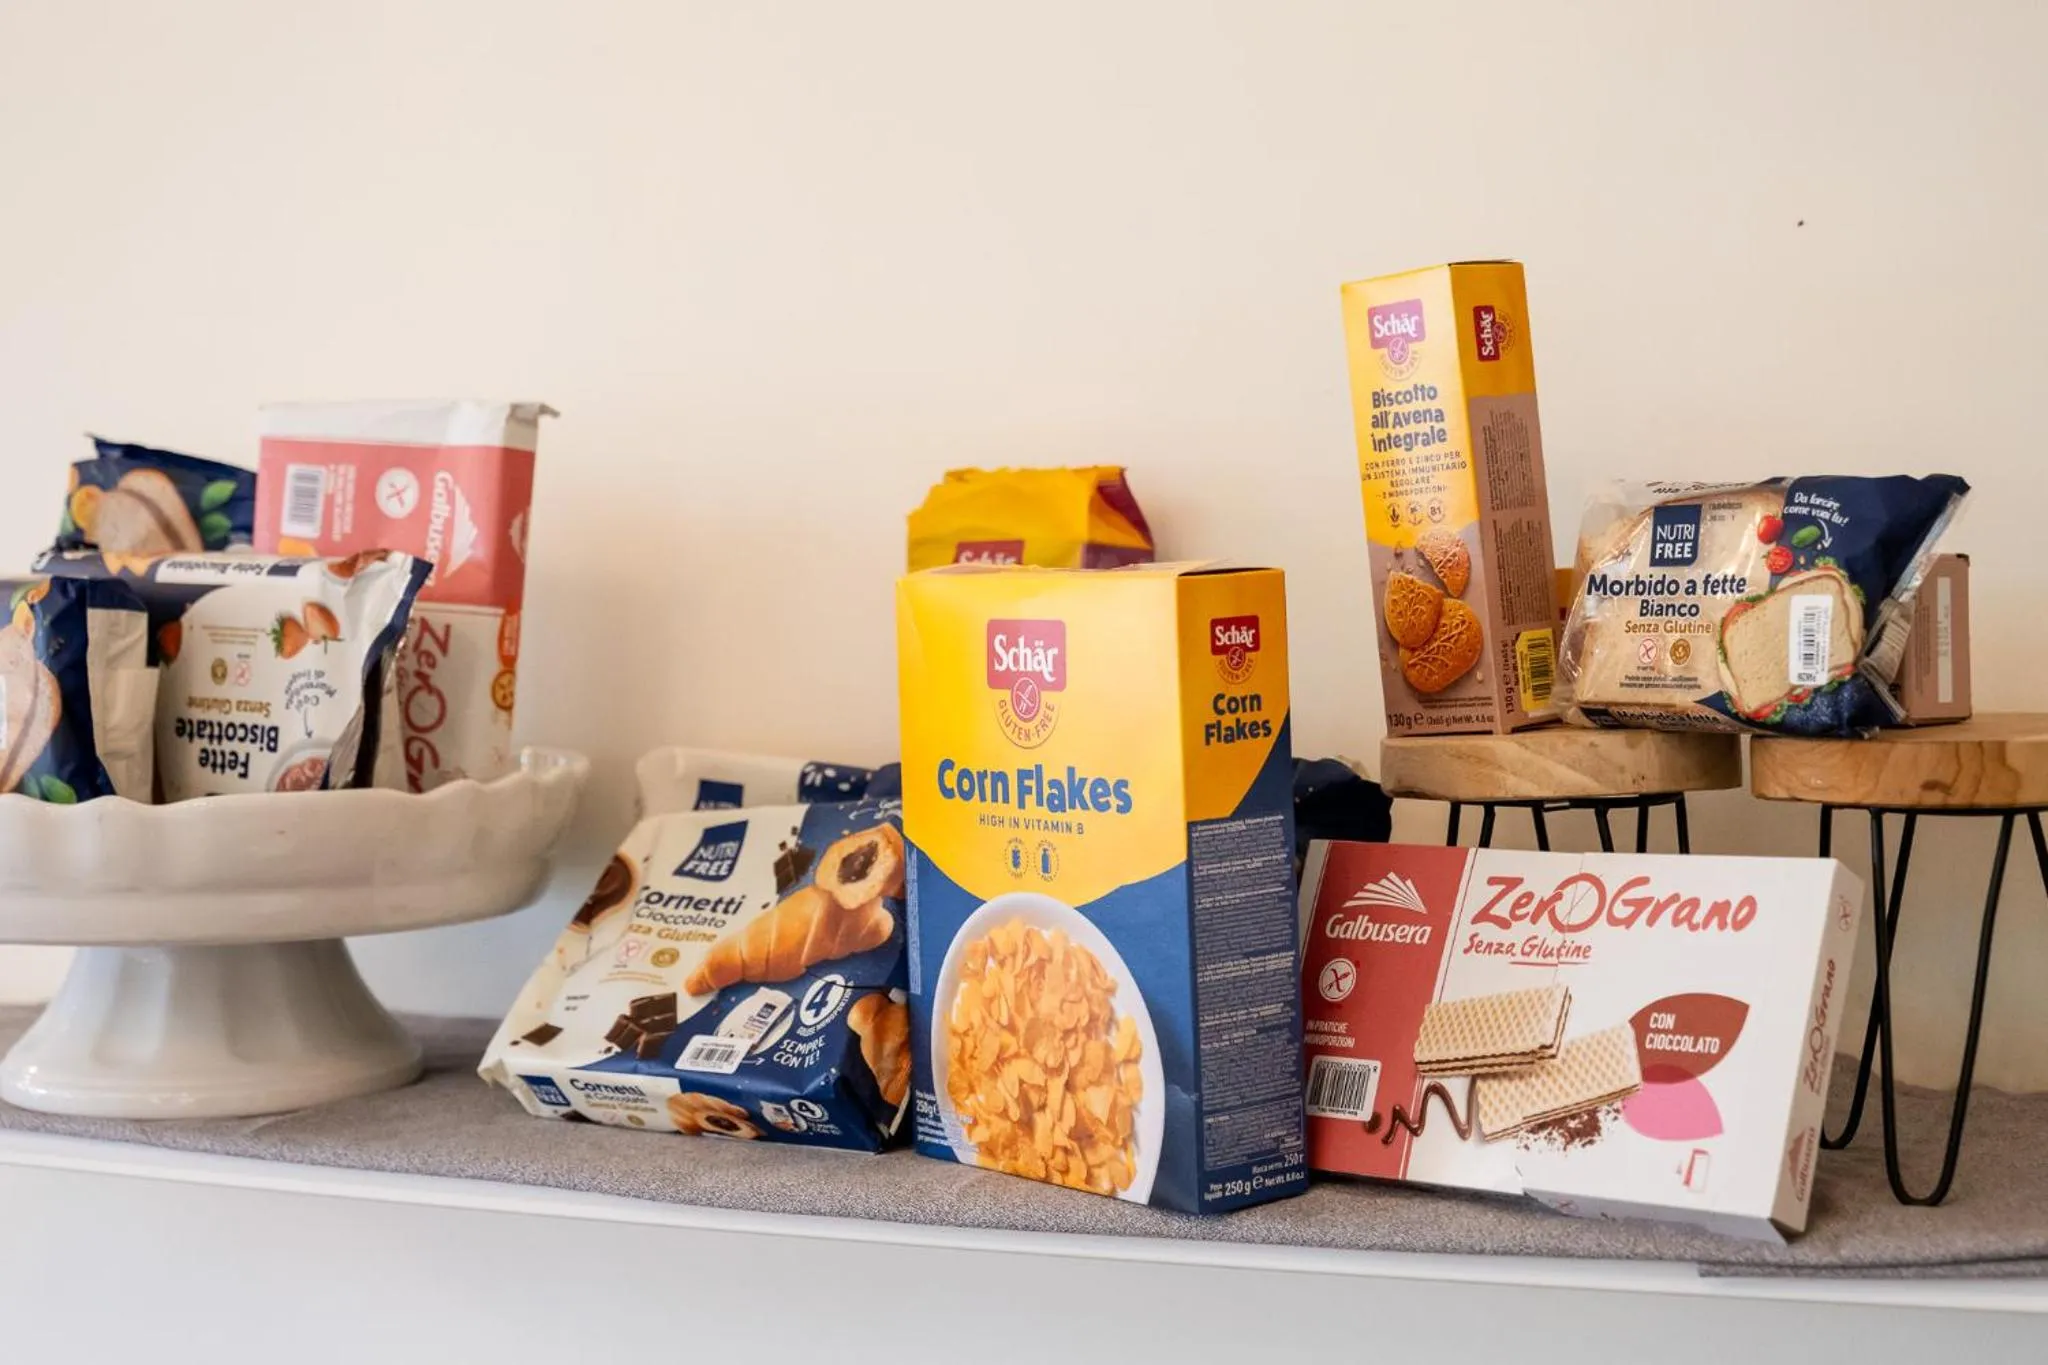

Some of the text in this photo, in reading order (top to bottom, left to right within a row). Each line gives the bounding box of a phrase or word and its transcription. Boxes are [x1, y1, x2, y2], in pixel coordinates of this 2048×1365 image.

[1372, 311, 1420, 339] Schär
[1480, 310, 1494, 356] Schär
[1371, 384, 1438, 409] Biscotto
[1371, 408, 1445, 430] all'Avena
[1371, 425, 1448, 452] integrale
[424, 468, 454, 588] Galbuse
[1655, 523, 1696, 541] NUTRI
[1655, 542, 1693, 559] FREE
[1586, 573, 1748, 597] Morbido a fette
[1639, 599, 1701, 618] Bianco
[1214, 624, 1256, 648] Schär
[1624, 620, 1713, 635] Senza Glutine
[993, 633, 1059, 682] Schär
[404, 617, 451, 794] ZerOGr
[1212, 692, 1262, 716] Corn
[998, 699, 1056, 742] GLUTEN-FREE
[1204, 717, 1272, 747] Flakes
[175, 717, 280, 753] Biscottate
[198, 747, 250, 778] Fette
[937, 758, 1133, 815] Corn Flakes
[979, 813, 1085, 835] HIGH IN VITAMIN B
[695, 841, 740, 860] NUTRI
[683, 860, 733, 876] FREE
[635, 906, 727, 929] Cioccolato
[1325, 912, 1432, 945] Galbusera
[656, 927, 718, 943] Glutine
[1462, 932, 1593, 962] Senza Glutine
[805, 980, 838, 1019] 4
[1649, 1012, 1676, 1030] CON
[778, 1035, 826, 1056] SEMPRE
[1644, 1034, 1720, 1056] CIOCCOLATO
[773, 1049, 821, 1069] CON TE!
[569, 1078, 648, 1097] Cornetti
[1225, 1179, 1244, 1196] 250
[1244, 1181, 1252, 1196] g
